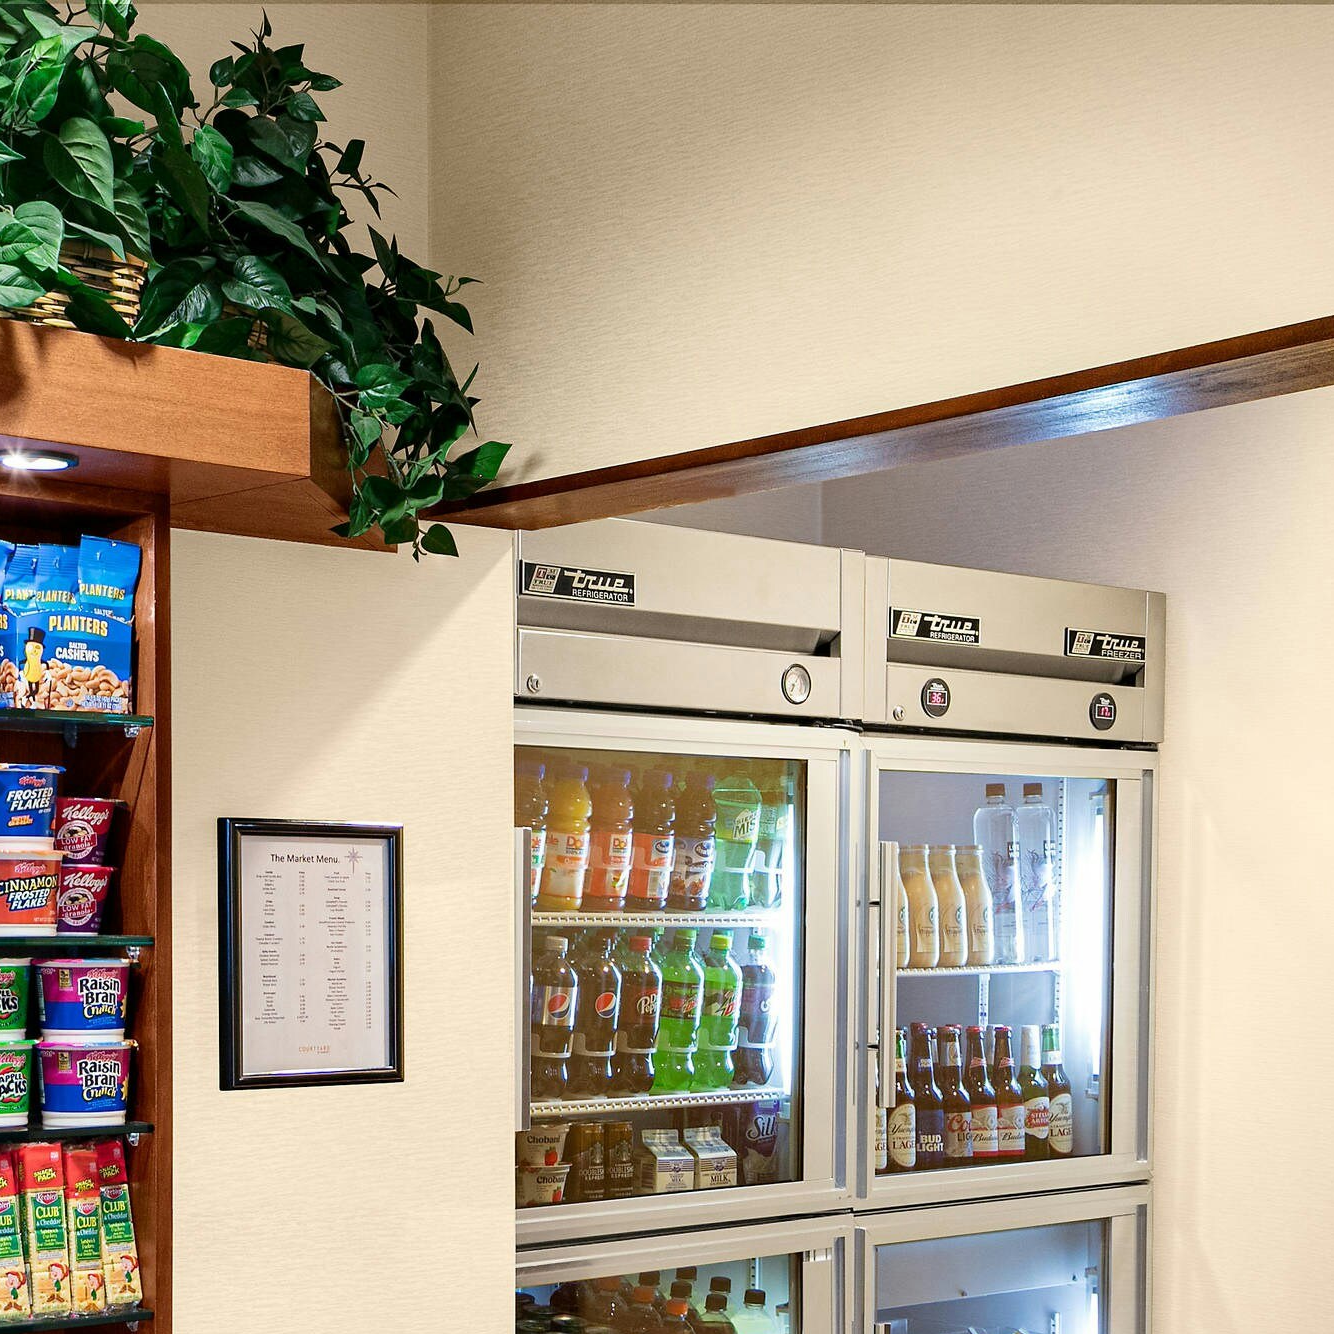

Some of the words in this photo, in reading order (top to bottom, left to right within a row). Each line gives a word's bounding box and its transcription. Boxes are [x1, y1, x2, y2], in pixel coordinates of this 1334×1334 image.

[79, 583, 125, 600] PLANTERS
[572, 589, 628, 601] REFRIGERATOR
[48, 615, 108, 637] PLANTERS
[55, 647, 100, 662] CASHEWS
[1101, 650, 1142, 660] FREEZER
[7, 788, 54, 803] FROSTED
[10, 798, 51, 812] FLAKES
[62, 805, 109, 825] Kellogg's
[270, 854, 285, 863] The
[287, 854, 314, 863] Market
[78, 978, 120, 993] Raisin
[85, 991, 116, 1005] Bran
[84, 1004, 117, 1018] Crunch
[892, 1140, 916, 1150] LAGE
[921, 1134, 942, 1144] BUD
[917, 1142, 944, 1152] LIGHT
[710, 1174, 729, 1183] MILK
[36, 1207, 59, 1217] CLUB
